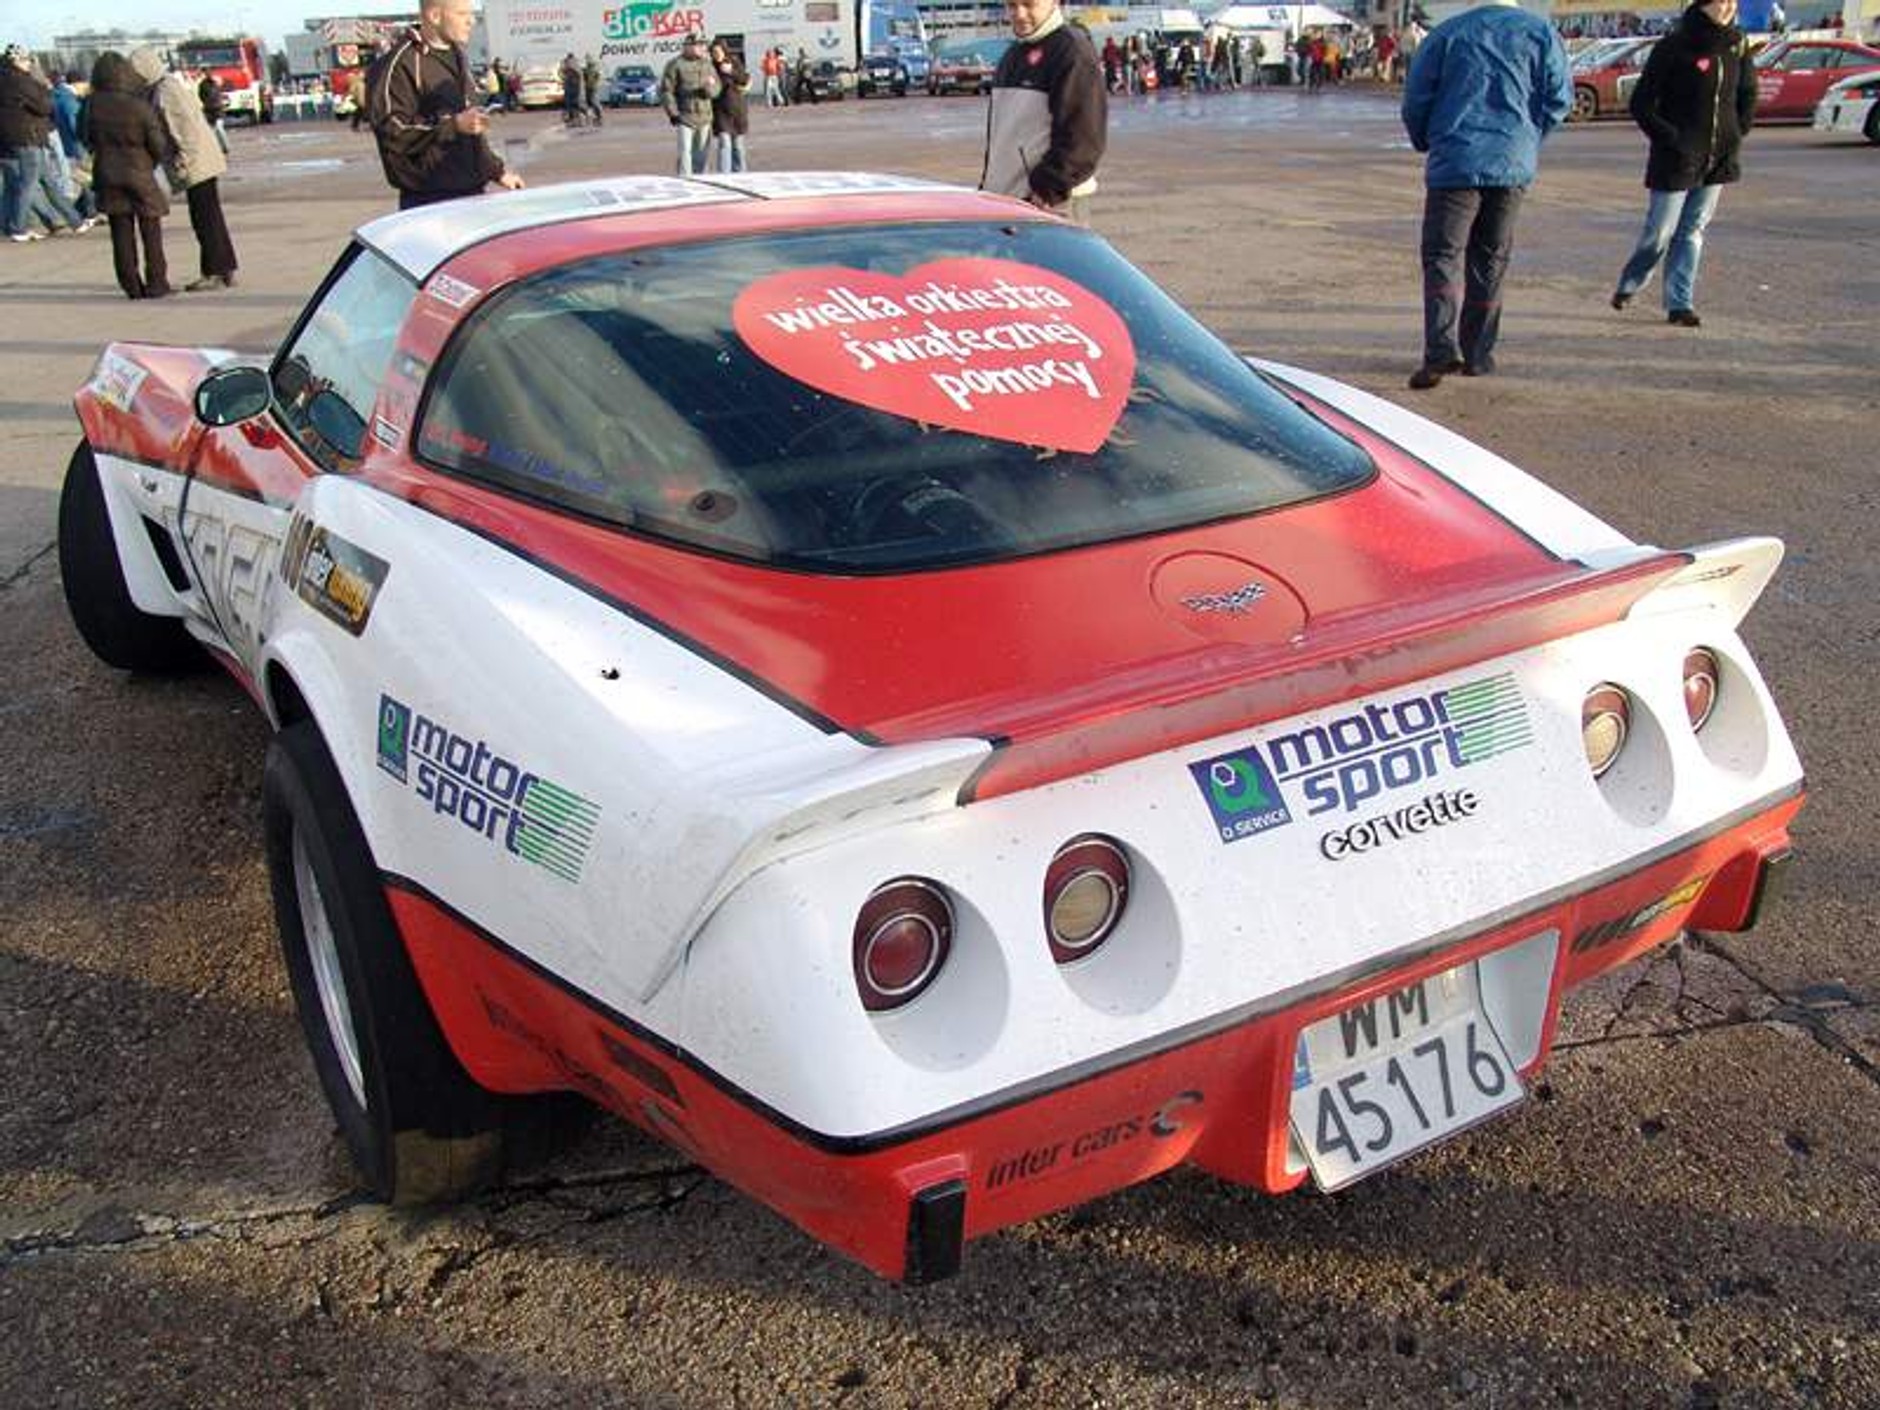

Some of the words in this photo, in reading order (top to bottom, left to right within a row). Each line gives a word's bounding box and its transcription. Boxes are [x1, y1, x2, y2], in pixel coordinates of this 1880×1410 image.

[599, 41, 648, 59] power
[764, 286, 906, 334] wielka
[906, 280, 1073, 315] orkiestra
[839, 314, 1102, 371] świątecznej
[931, 357, 1102, 411] pomocy
[411, 714, 540, 806] motor
[1266, 691, 1450, 774] motor
[415, 763, 525, 856] sport
[1303, 729, 1472, 816] sport
[1320, 788, 1482, 861] corvette
[1339, 980, 1429, 1058] WM
[1315, 1022, 1505, 1163] 45176
